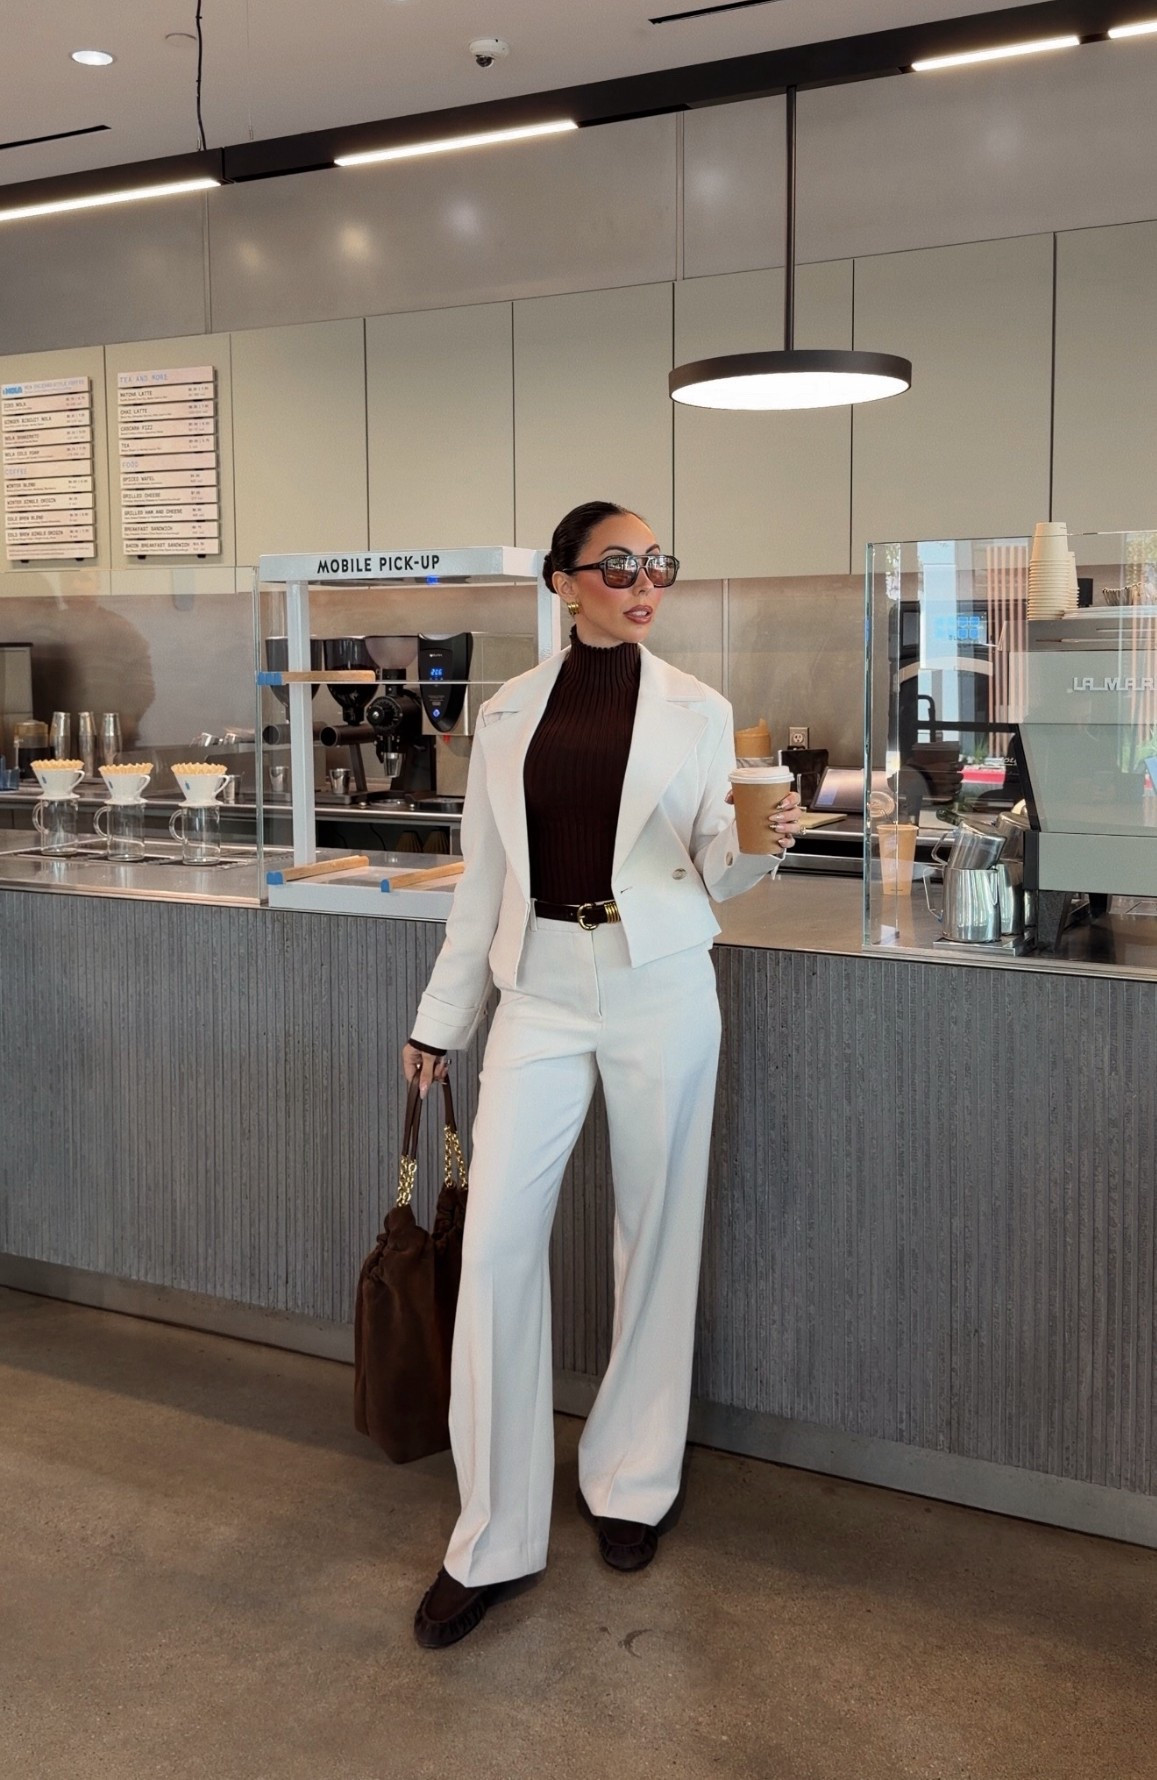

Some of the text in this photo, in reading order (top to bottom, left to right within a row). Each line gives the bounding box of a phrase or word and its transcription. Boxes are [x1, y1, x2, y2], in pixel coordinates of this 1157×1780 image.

[317, 555, 440, 574] MOBILE PICK-UP
[1073, 677, 1094, 690] LA
